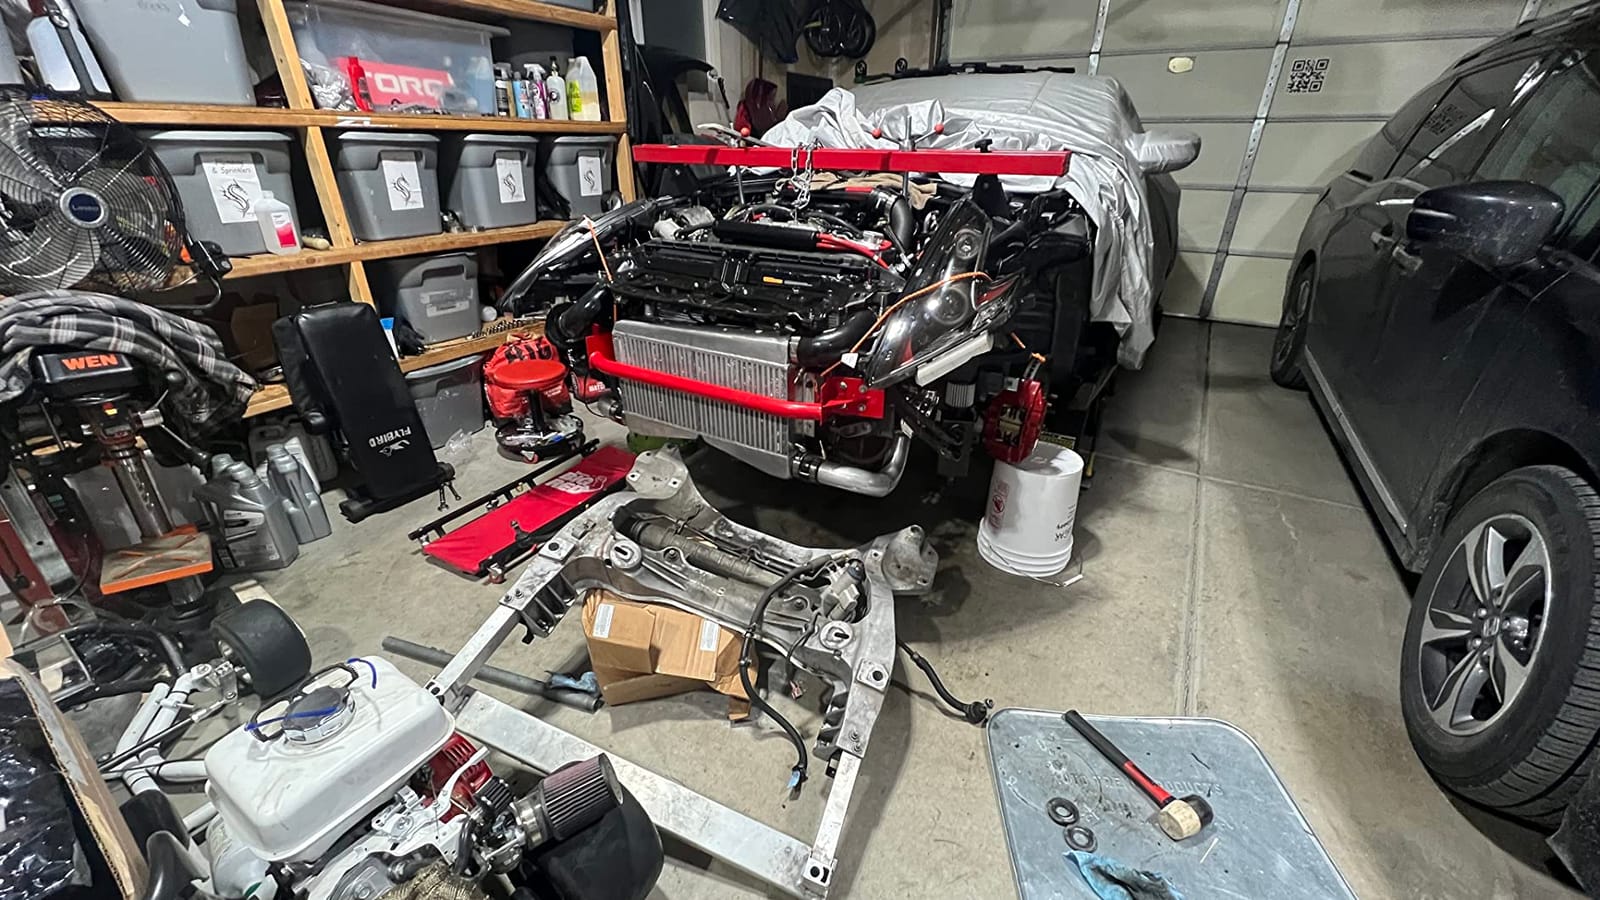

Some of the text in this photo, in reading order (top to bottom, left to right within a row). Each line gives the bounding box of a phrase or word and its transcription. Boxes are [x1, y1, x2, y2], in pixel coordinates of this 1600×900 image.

[61, 353, 119, 371] WEN
[368, 426, 412, 448] FLYBIRD
[1164, 781, 1224, 796] ODUCTS
